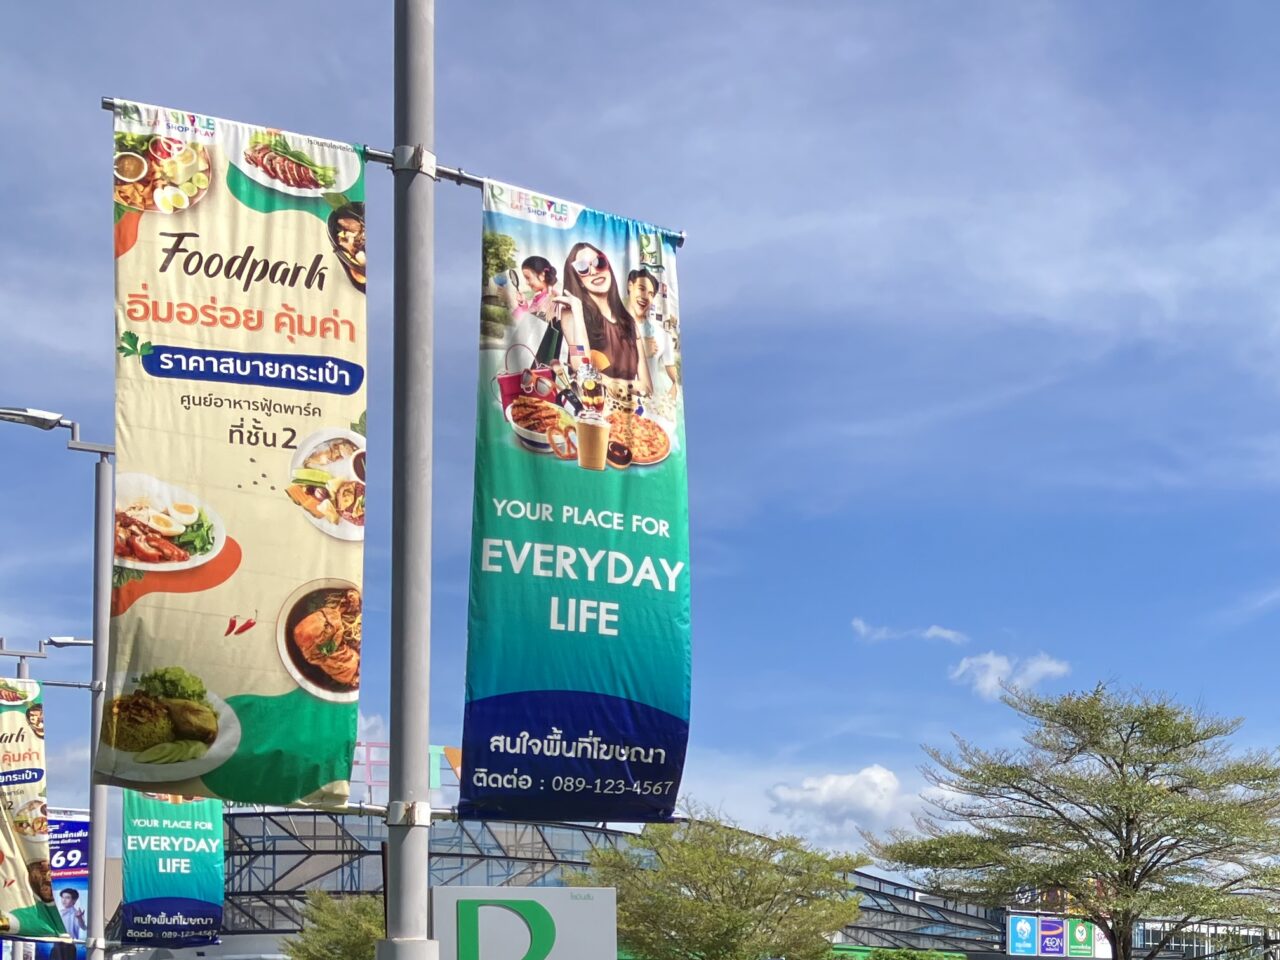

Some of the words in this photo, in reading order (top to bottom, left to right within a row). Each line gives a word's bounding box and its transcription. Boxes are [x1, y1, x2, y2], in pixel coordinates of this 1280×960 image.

[165, 122, 190, 132] SHOP
[527, 207, 547, 216] SHOP
[551, 213, 568, 222] PLAY
[158, 231, 329, 291] Foodpark
[126, 283, 264, 332] อิ่มอร่อย
[274, 303, 356, 344] คุ้มค่า
[159, 350, 350, 386] ราคาสบายกระเป๋า
[228, 418, 277, 449] ที่ชั้น
[281, 427, 298, 450] 2
[492, 498, 553, 523] YOUR
[562, 506, 625, 531] PLACE
[632, 515, 671, 538] FOR
[481, 538, 685, 592] EVERYDAY
[550, 597, 619, 636] LIFE
[0, 727, 24, 743] ark
[490, 727, 666, 765] สนใจพื้นที่โฆษณา
[473, 768, 533, 790] ติดต่อ
[551, 776, 674, 796] 089-123-4567
[132, 819, 159, 828] YOUR
[162, 820, 192, 830] PLACE
[194, 821, 214, 831] FOR
[50, 849, 82, 868] 69
[127, 835, 221, 853] EVERYDAY
[158, 857, 191, 874] LIFE
